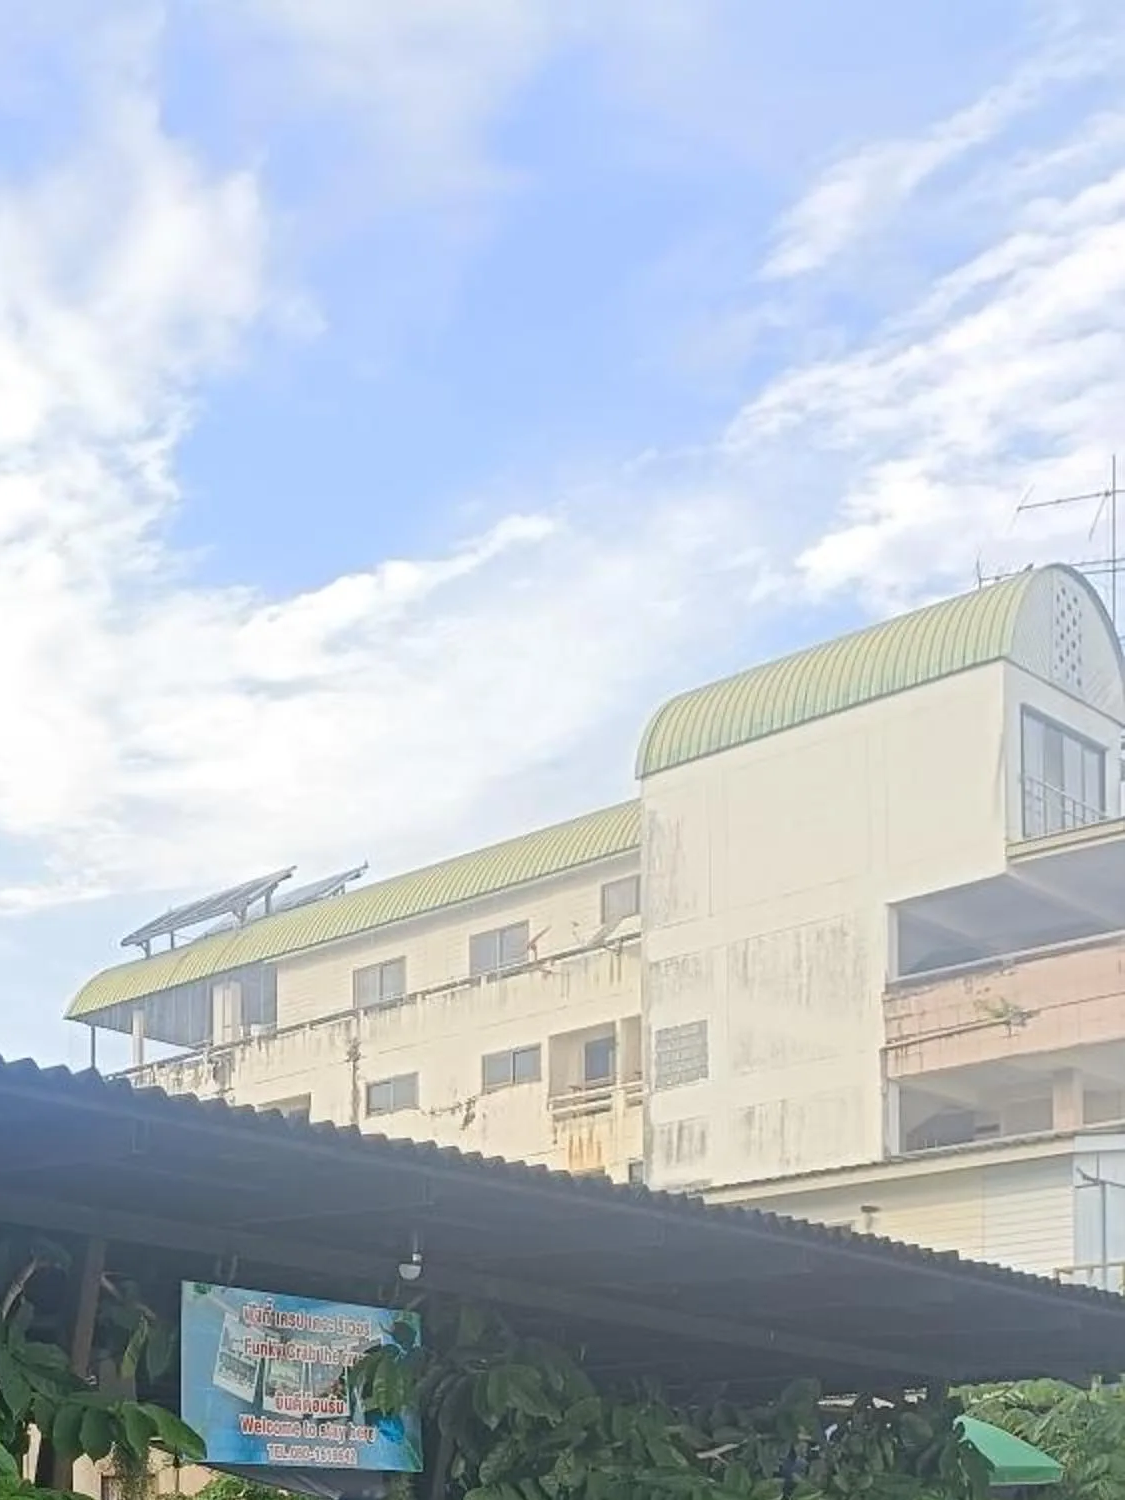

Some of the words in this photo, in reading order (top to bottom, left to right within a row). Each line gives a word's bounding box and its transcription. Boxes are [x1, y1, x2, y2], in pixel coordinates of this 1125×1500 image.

[244, 1337, 281, 1360] Funky
[241, 1415, 300, 1437] Welcome
[303, 1420, 317, 1437] to
